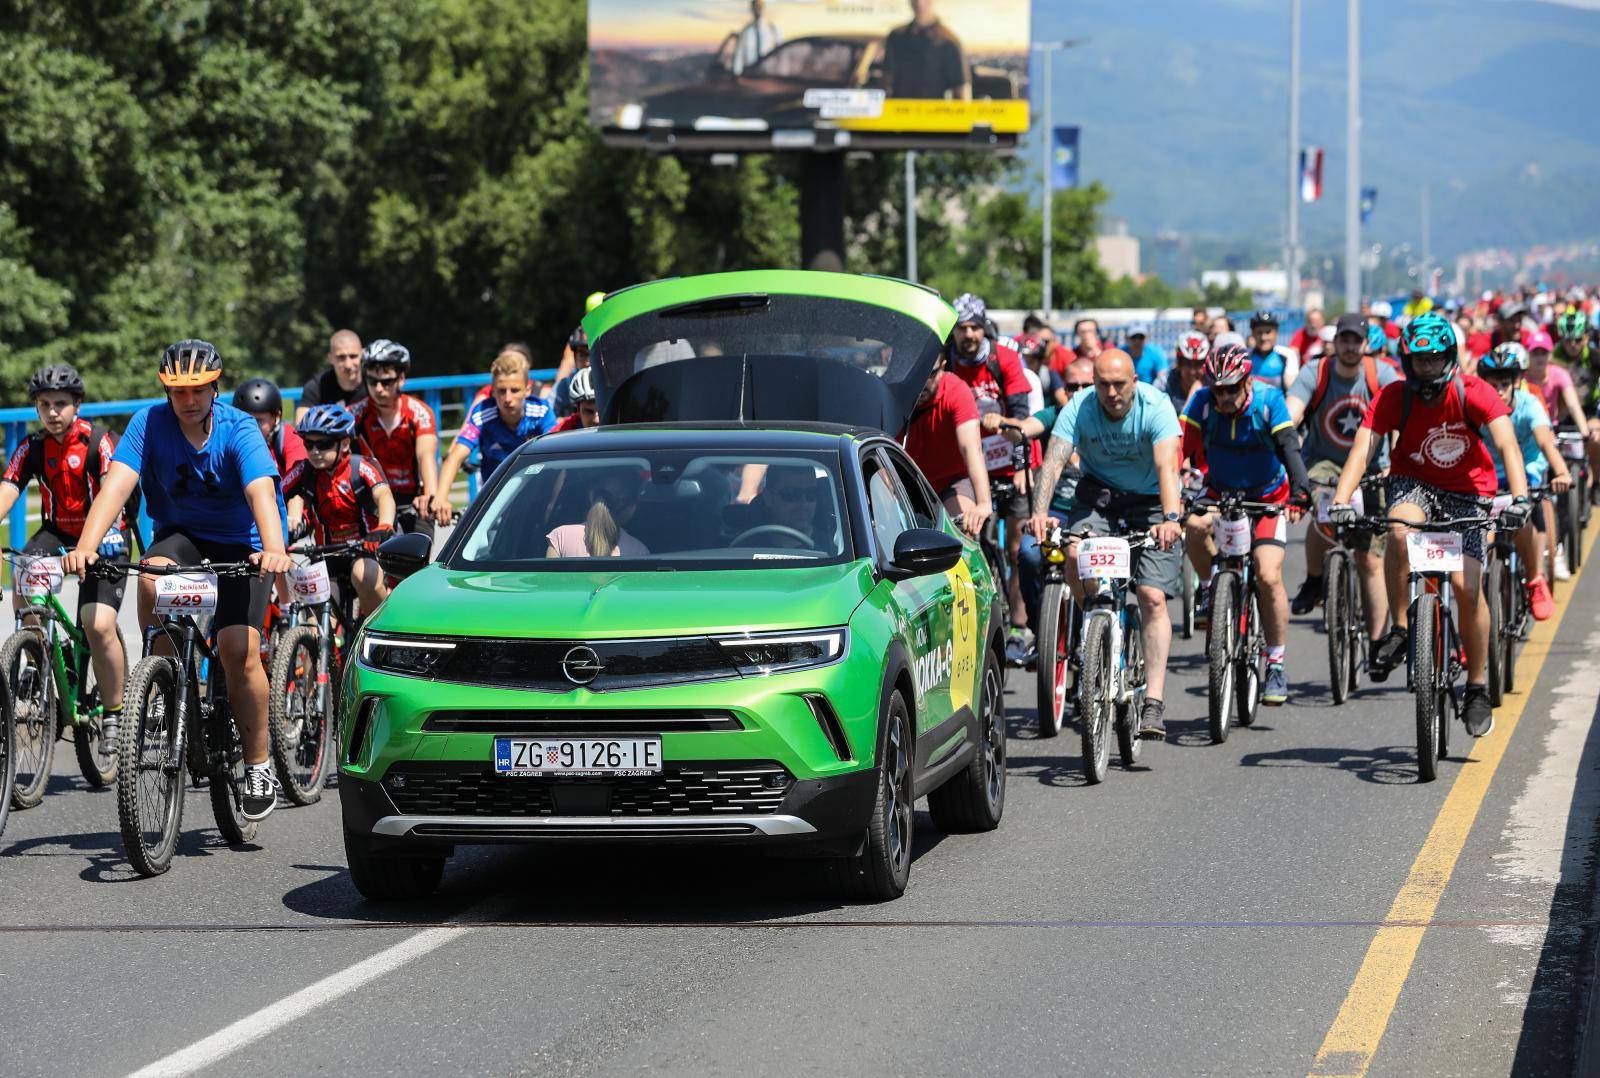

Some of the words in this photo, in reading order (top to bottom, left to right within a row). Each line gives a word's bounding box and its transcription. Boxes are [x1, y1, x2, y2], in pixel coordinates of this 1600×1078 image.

[1427, 549, 1444, 559] 89
[1090, 554, 1116, 566] 532
[293, 583, 317, 594] 433
[170, 594, 203, 606] 429
[513, 742, 543, 768] ZG
[498, 758, 511, 767] HR
